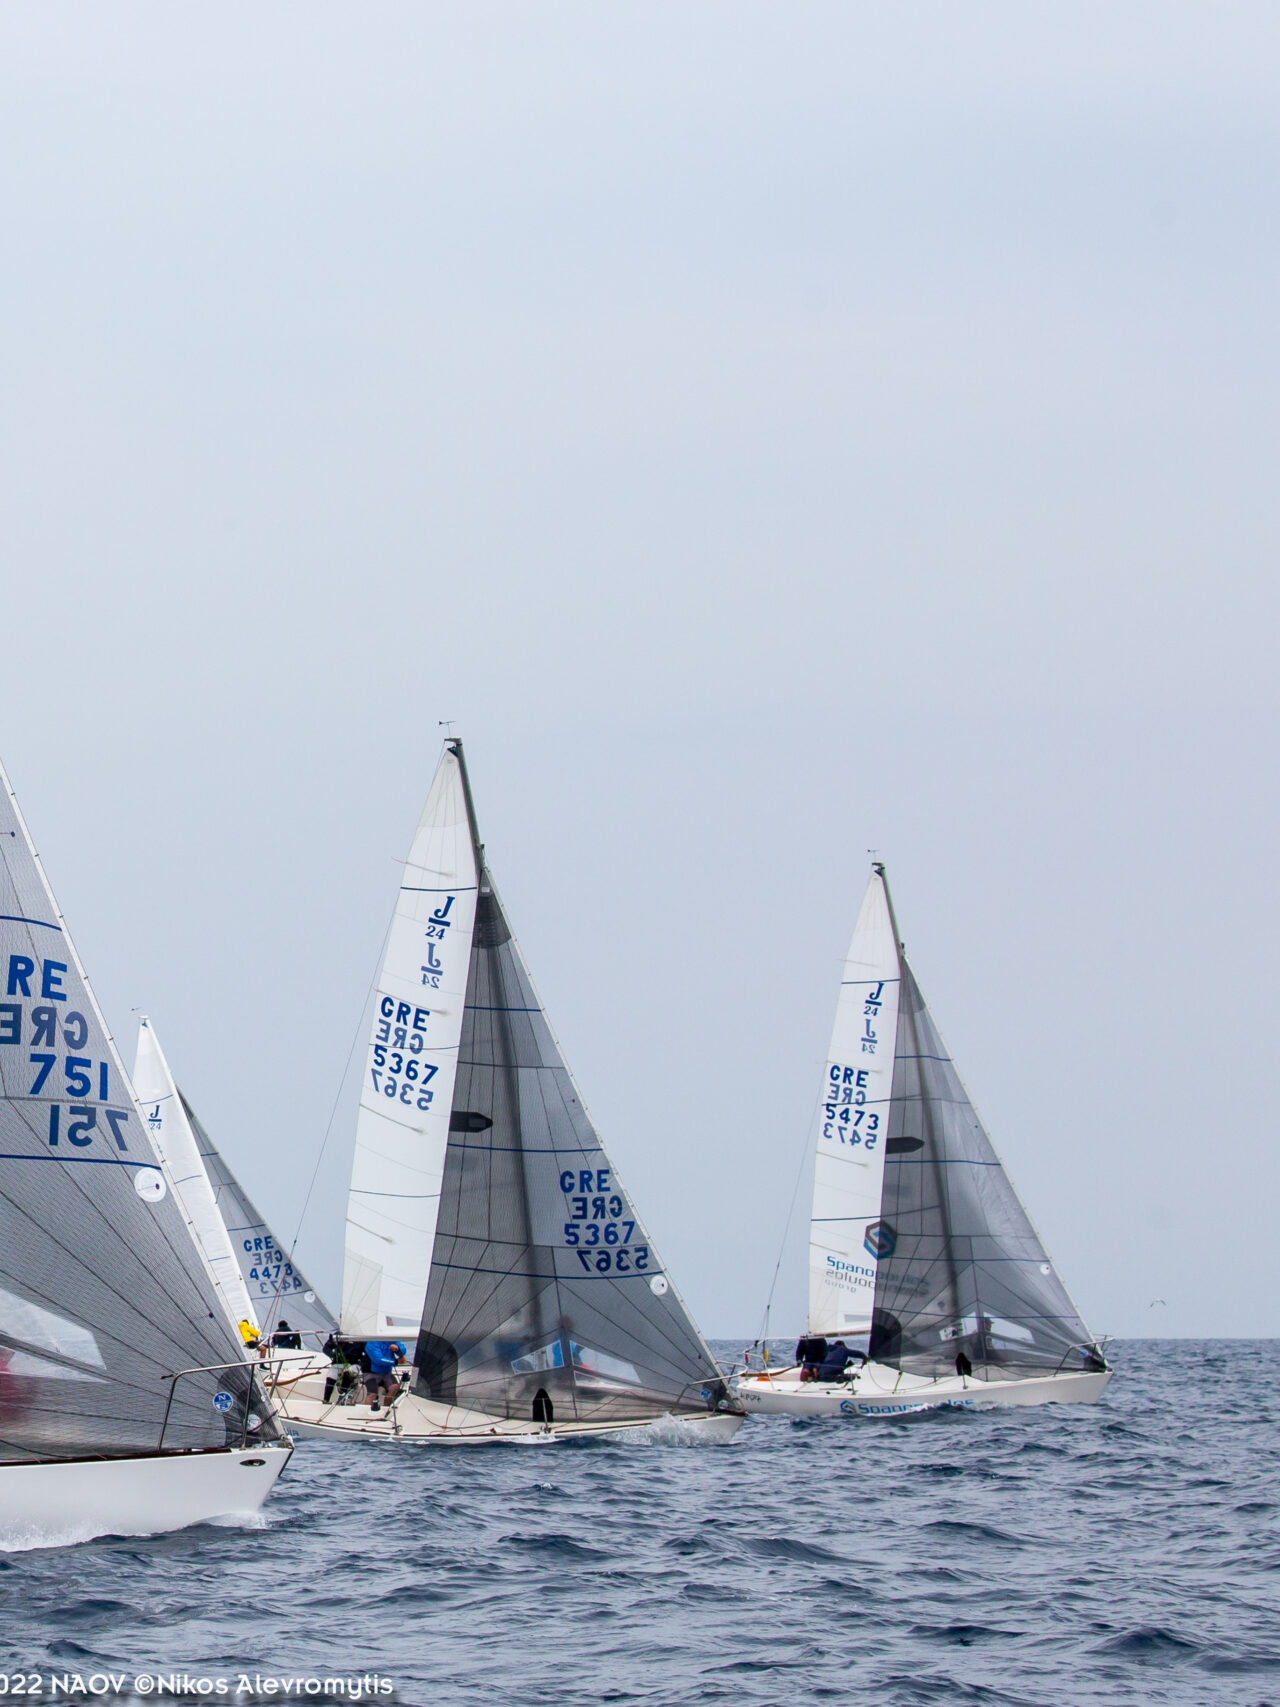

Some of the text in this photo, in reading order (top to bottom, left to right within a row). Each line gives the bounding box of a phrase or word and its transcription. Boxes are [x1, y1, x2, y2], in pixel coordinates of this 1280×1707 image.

[433, 895, 456, 919] J
[425, 925, 445, 940] 24
[869, 982, 884, 1000] J
[380, 996, 430, 1032] GRE
[863, 1005, 878, 1016] 24
[29, 1053, 108, 1100] 751
[373, 1044, 439, 1085] 5367
[830, 1064, 869, 1089] GRE
[150, 1105, 160, 1118] J
[825, 1103, 879, 1131] 5473
[150, 1122, 161, 1130] 24
[560, 1169, 611, 1193] GRE
[243, 1235, 274, 1252] GRE
[564, 1221, 635, 1246] 5367
[249, 1263, 293, 1280] 4473
